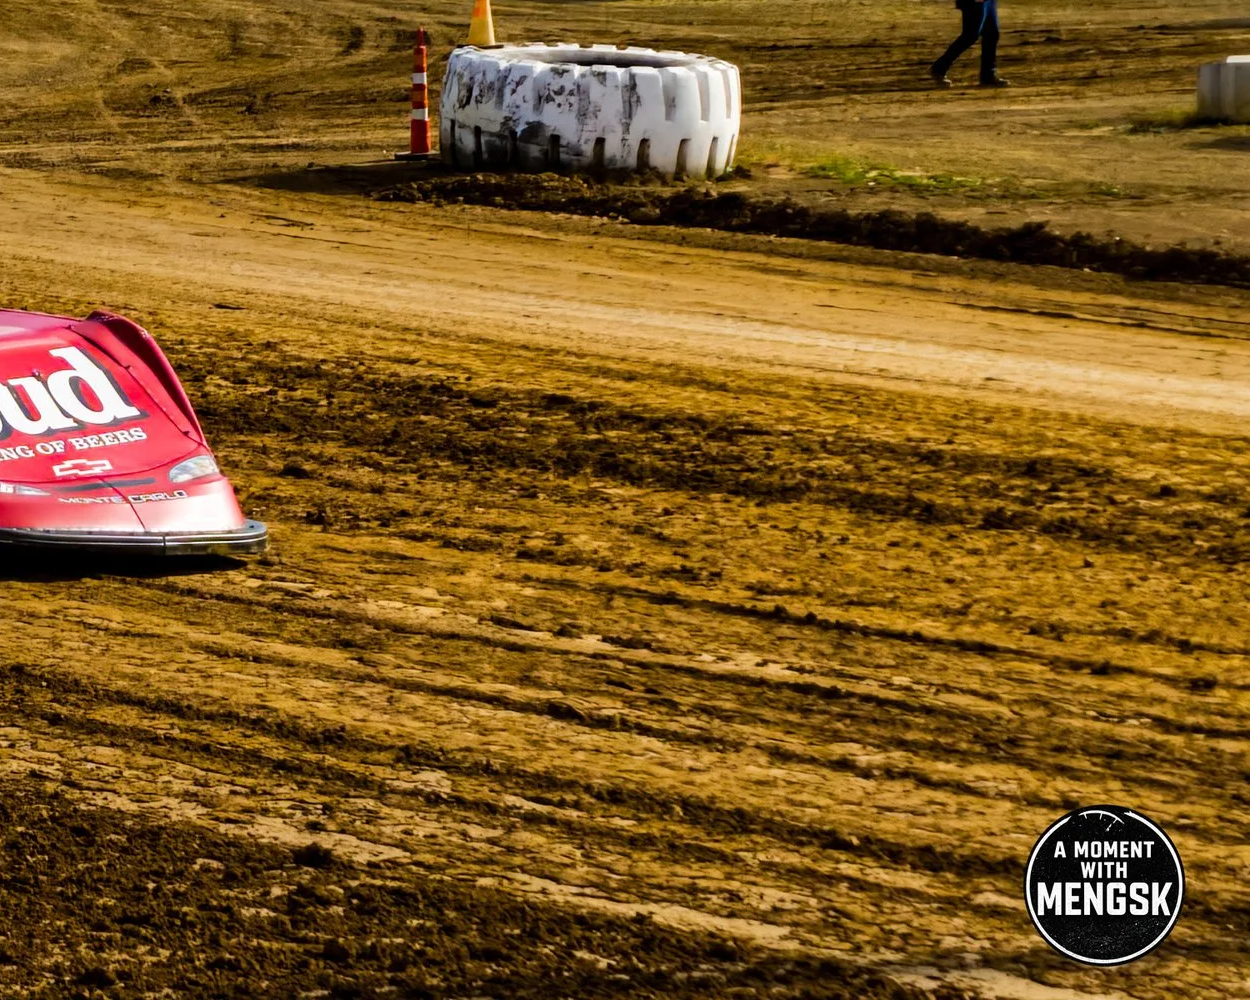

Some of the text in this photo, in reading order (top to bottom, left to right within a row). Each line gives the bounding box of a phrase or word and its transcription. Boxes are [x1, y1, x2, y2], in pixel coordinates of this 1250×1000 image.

[36, 439, 66, 456] OF
[71, 427, 147, 452] BEERS
[58, 489, 188, 504] MONTE CARLO
